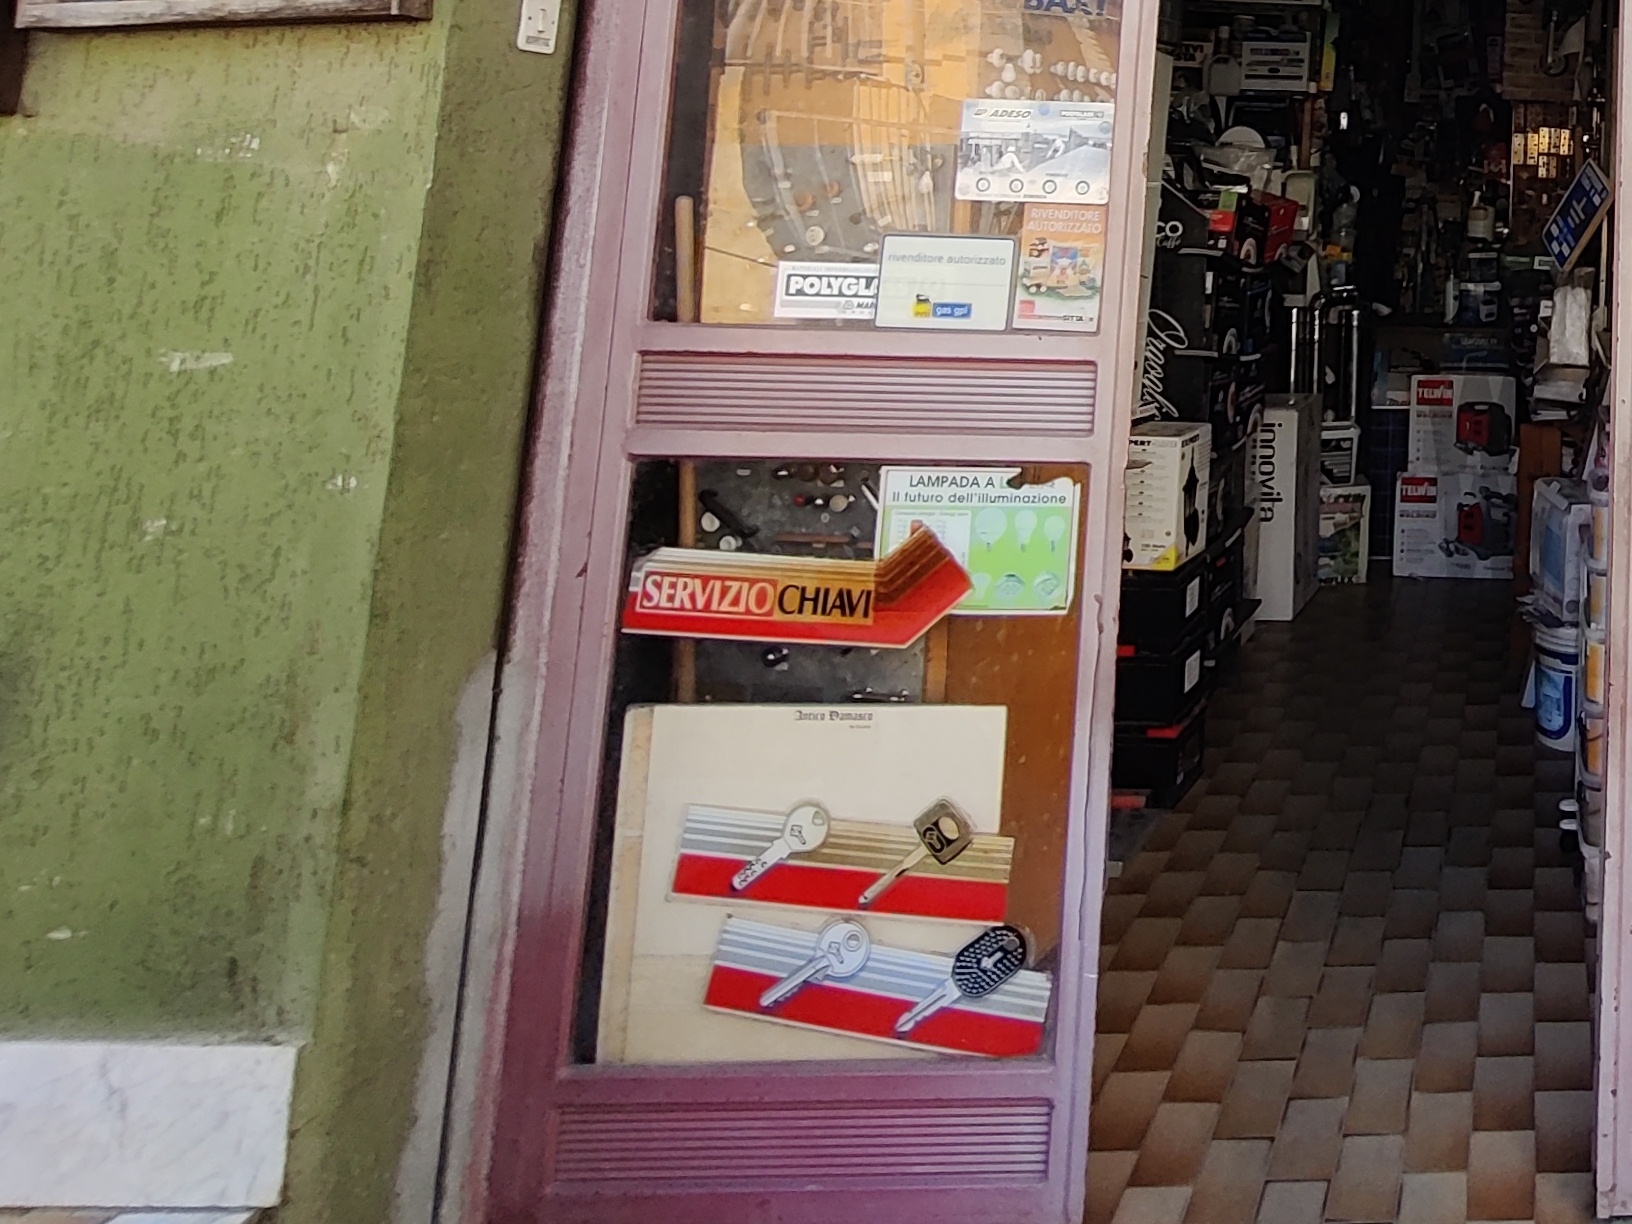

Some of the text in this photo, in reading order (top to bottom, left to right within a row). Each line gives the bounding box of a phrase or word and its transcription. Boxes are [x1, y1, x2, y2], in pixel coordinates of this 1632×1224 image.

[1031, 208, 1101, 222] RIVENDITORE
[1027, 221, 1102, 234] AUTORIZZATO
[888, 252, 1006, 266] rivenditore autorizzato
[935, 306, 952, 316] gas
[953, 306, 969, 317] gpl
[909, 474, 981, 489] LAMPADA
[984, 476, 995, 489] A
[892, 491, 1067, 505] Il futuro dell'illuminazione
[642, 575, 872, 619] SERVIZIO CHIAVI
